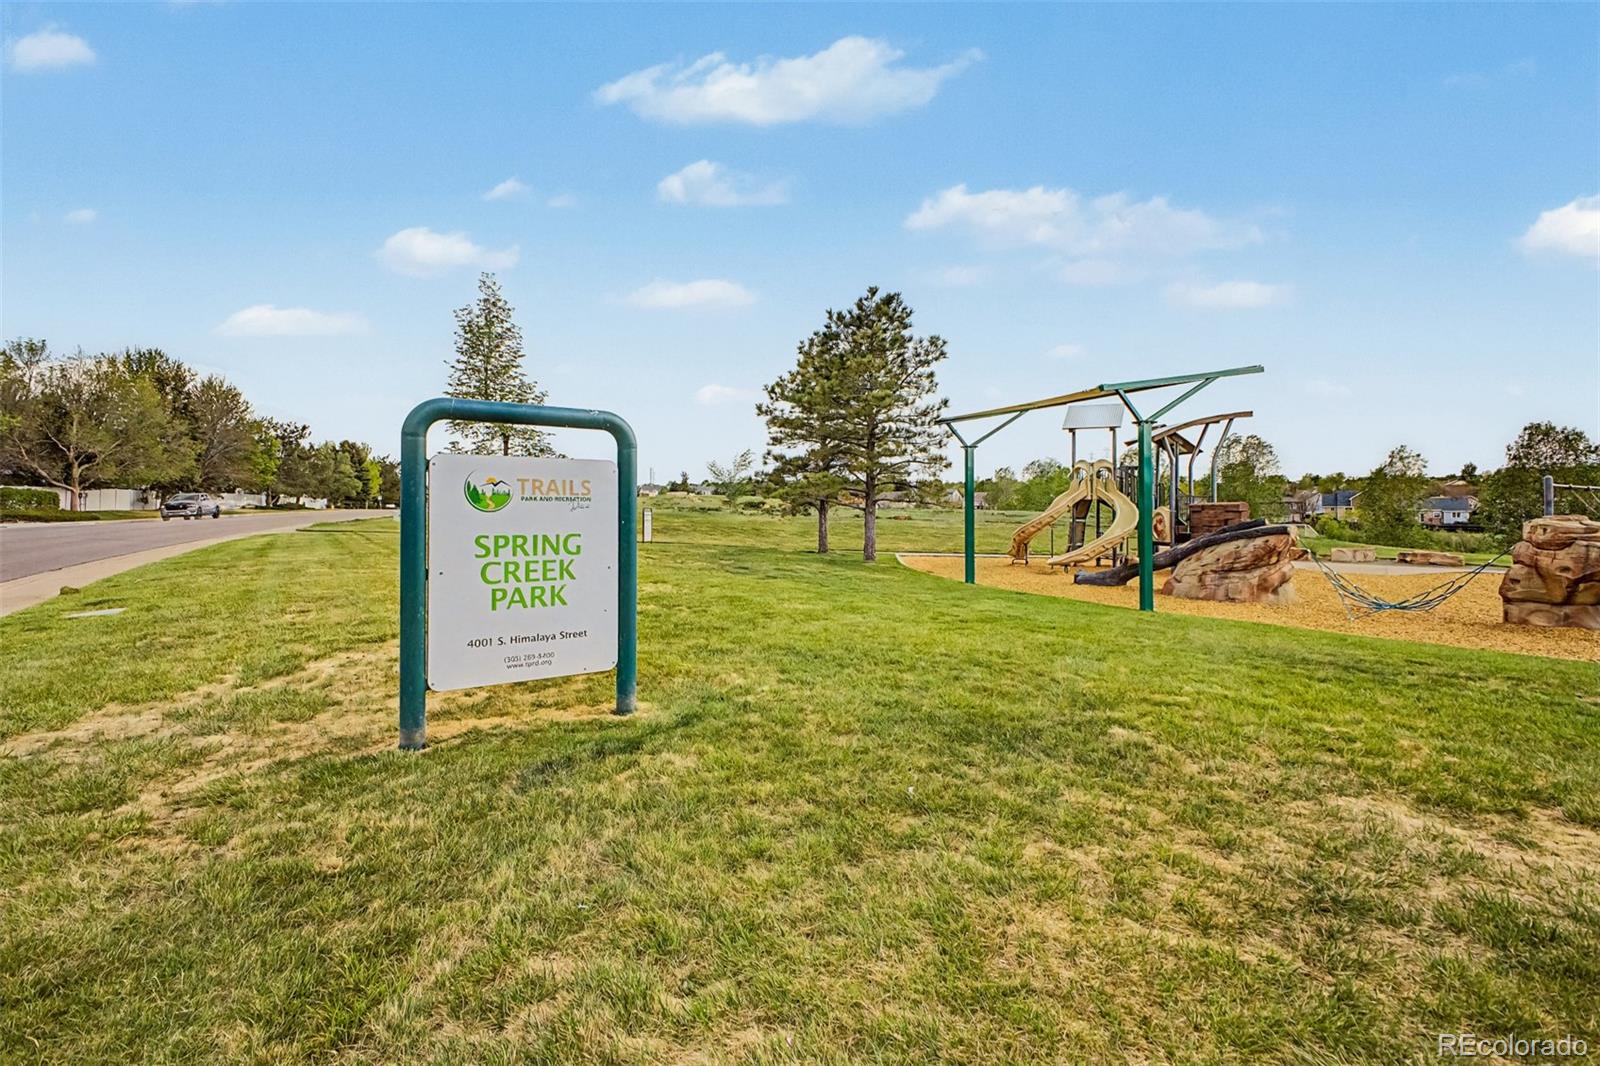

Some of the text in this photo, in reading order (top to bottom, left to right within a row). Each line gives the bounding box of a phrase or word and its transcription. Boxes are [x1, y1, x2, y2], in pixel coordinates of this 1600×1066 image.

[516, 478, 591, 496] TRAILS
[474, 533, 581, 558] SPRING
[480, 559, 576, 584] CREEK
[491, 584, 568, 611] PARK
[467, 630, 588, 648] 4001 S. Himalaya Street
